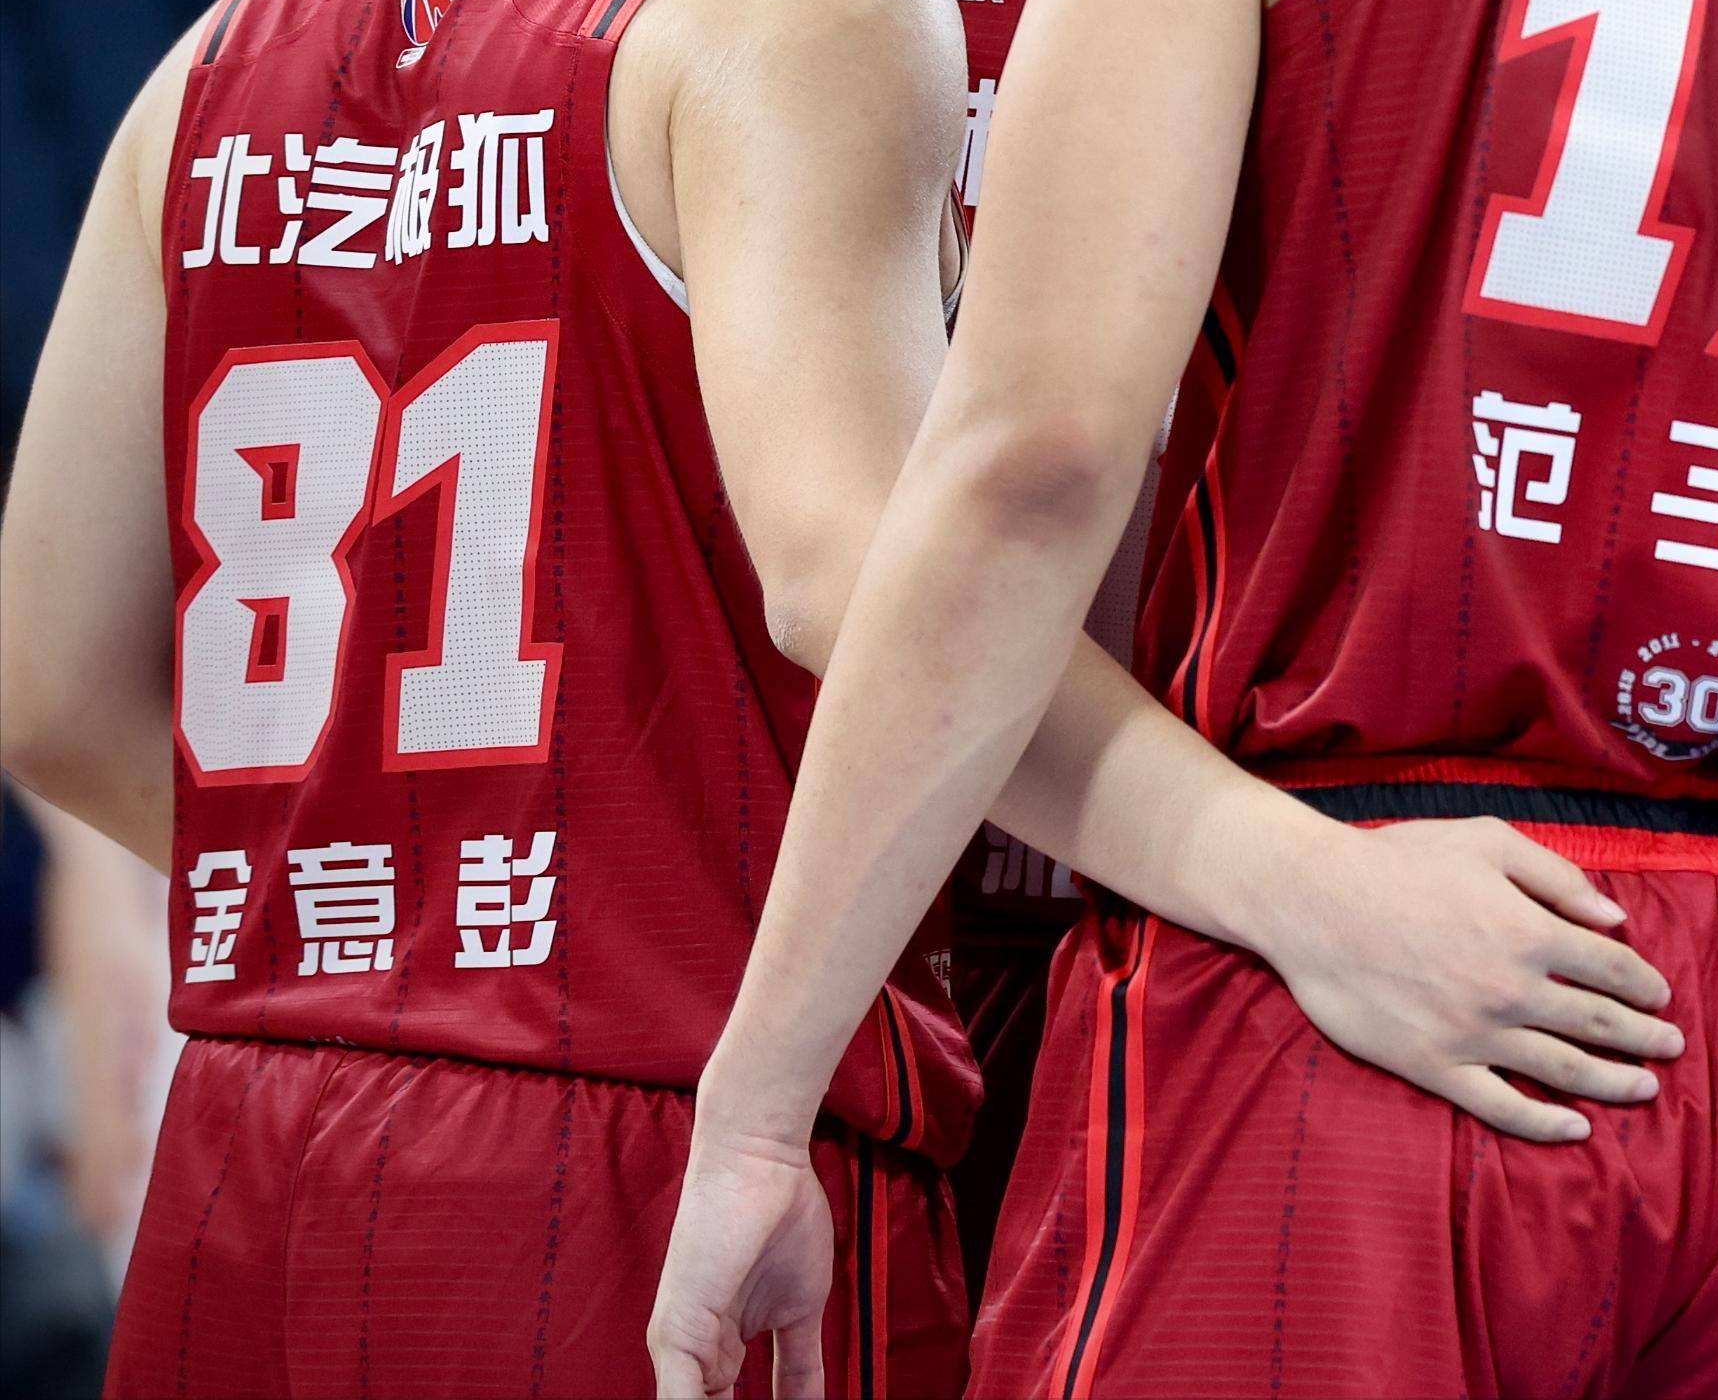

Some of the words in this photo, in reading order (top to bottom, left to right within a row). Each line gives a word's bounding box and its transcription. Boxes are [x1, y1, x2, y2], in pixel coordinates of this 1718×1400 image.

[182, 108, 555, 269] 北汽极狐
[173, 319, 564, 788] 81
[183, 830, 558, 985] 金意彭
